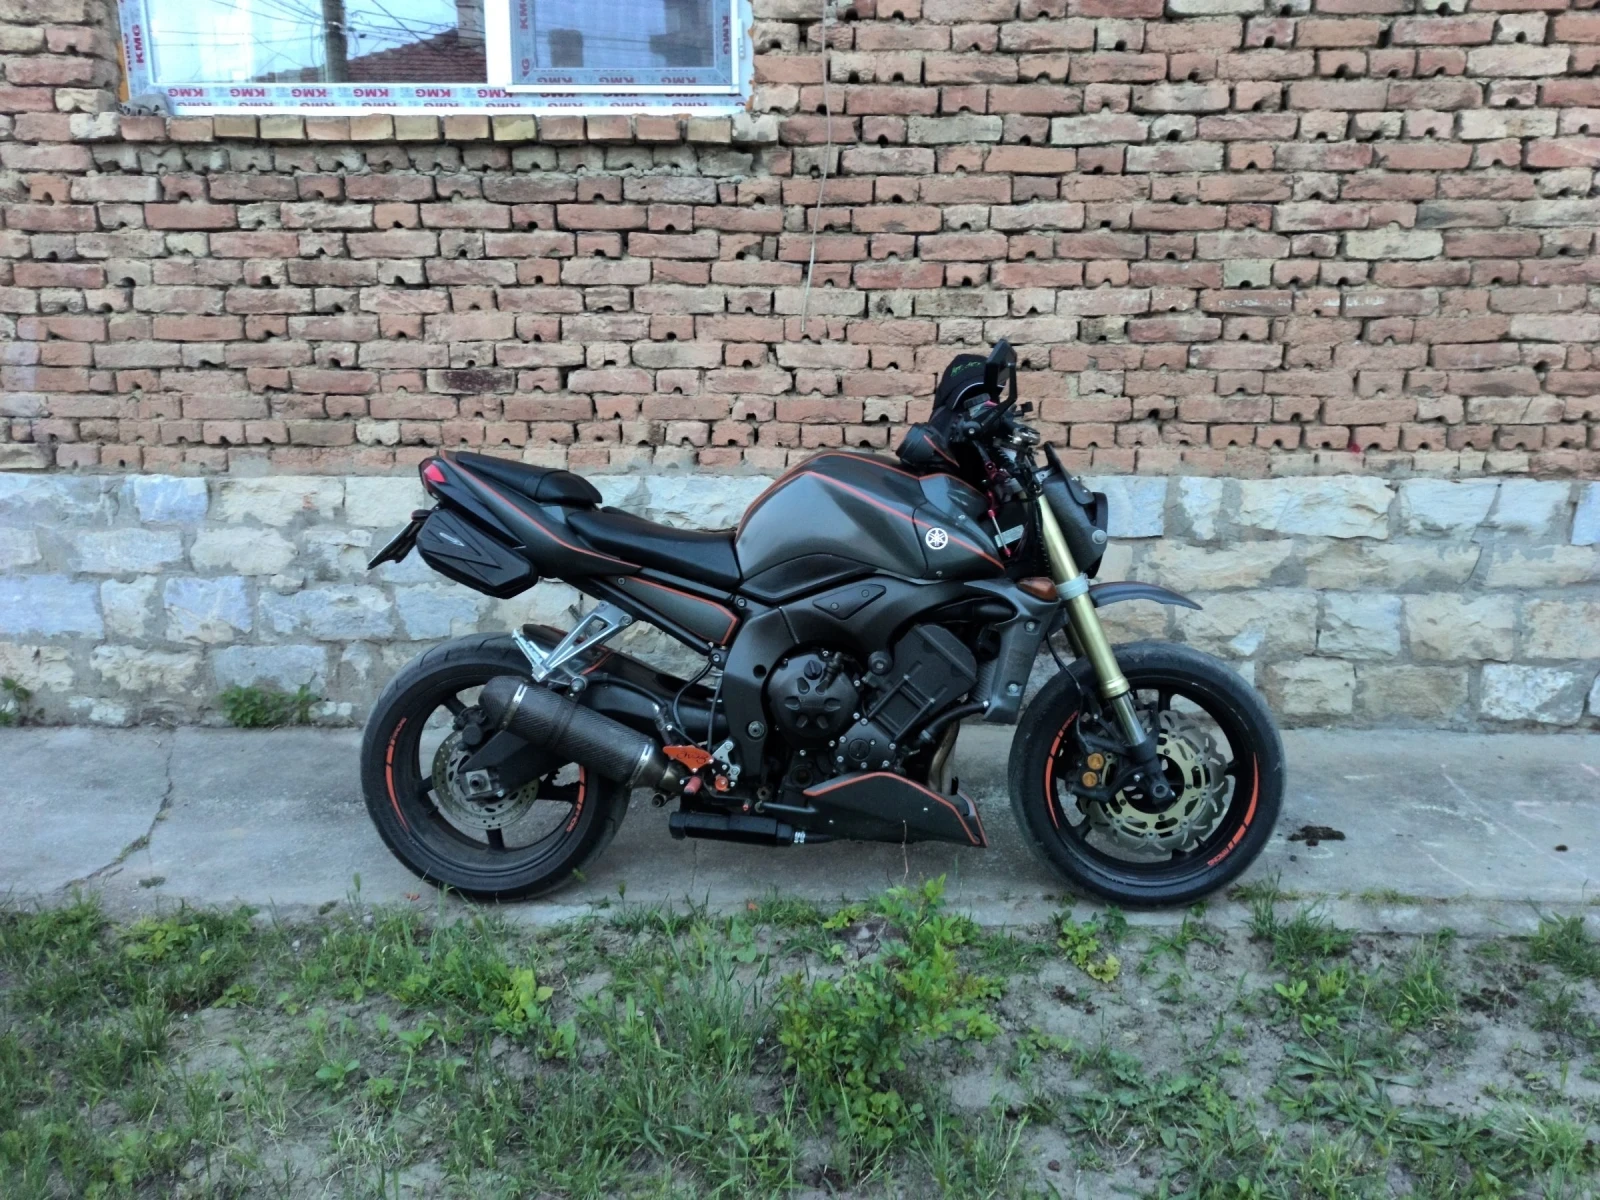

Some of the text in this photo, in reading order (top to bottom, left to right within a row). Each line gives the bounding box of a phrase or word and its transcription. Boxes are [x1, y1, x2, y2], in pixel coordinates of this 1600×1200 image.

[519, 0, 529, 29] KM
[132, 24, 144, 64] KMG
[722, 16, 730, 55] KMG
[168, 88, 204, 97] KMG
[230, 88, 265, 97] KMG
[291, 88, 327, 97] KMG
[353, 88, 389, 97] KMG
[415, 88, 451, 97] KMG
[477, 89, 513, 98] KMG
